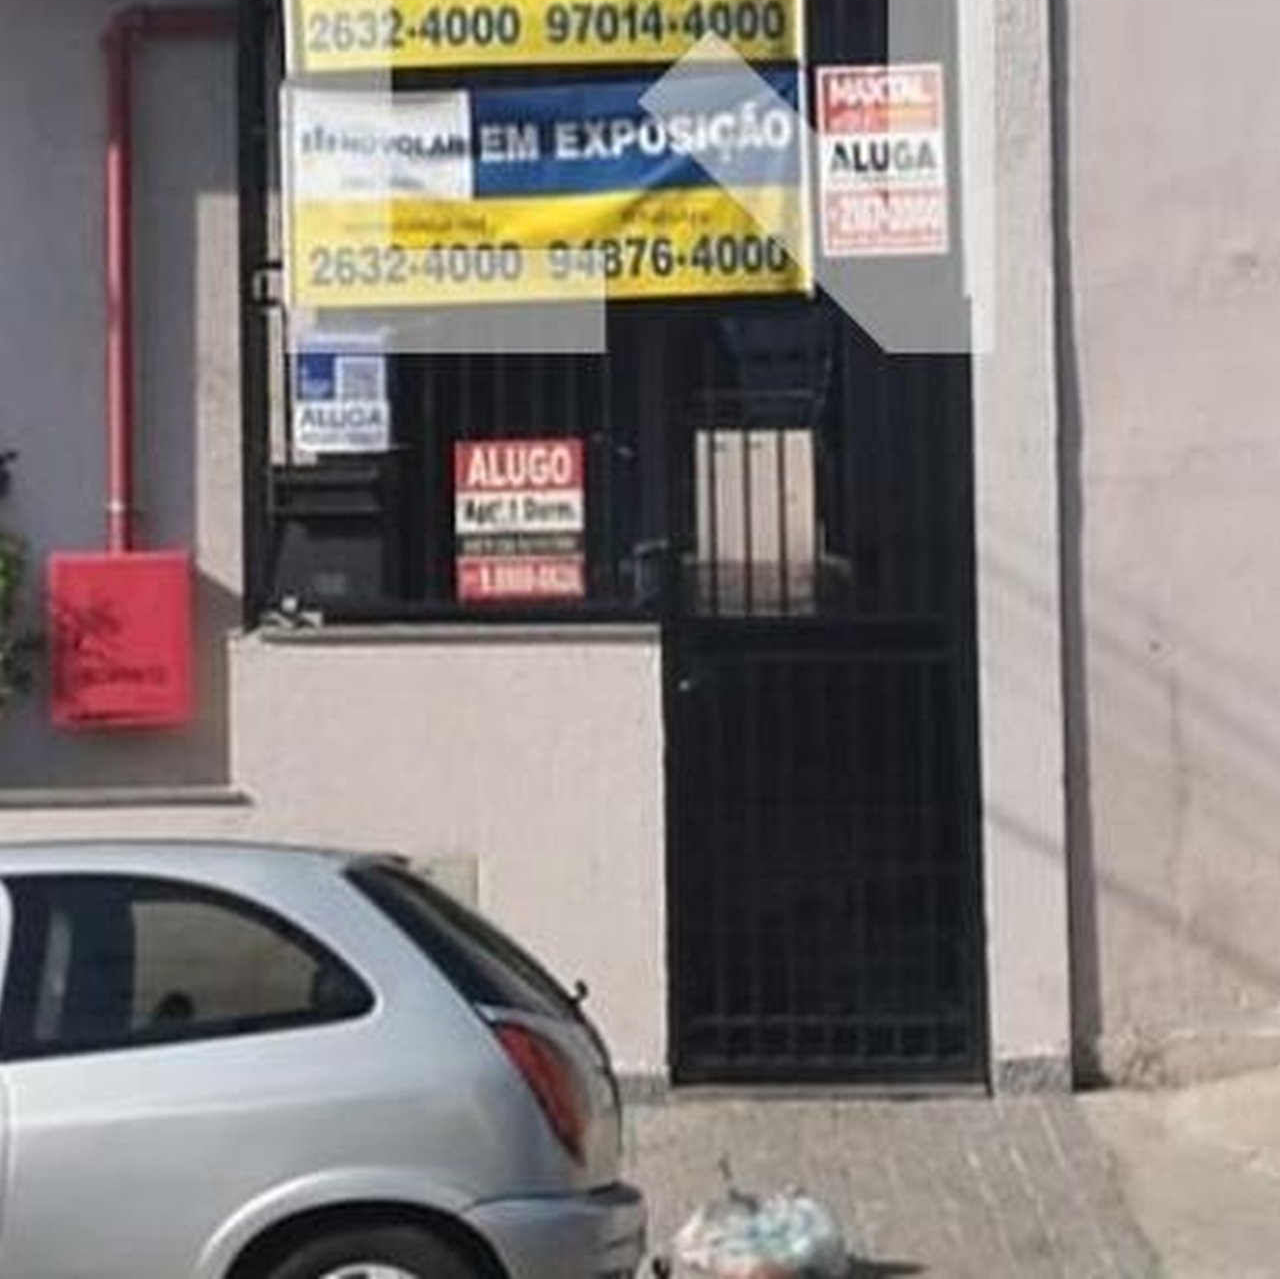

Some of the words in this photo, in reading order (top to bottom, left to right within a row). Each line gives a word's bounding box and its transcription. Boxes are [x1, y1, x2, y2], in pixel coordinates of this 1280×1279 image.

[309, 5, 521, 52] 2632-4000
[546, 0, 786, 45] 97014-4000
[479, 123, 539, 162] EM
[555, 99, 792, 162] EXPOSIÇÃO
[830, 139, 936, 174] ALUGA
[310, 241, 523, 285] 2632-4000
[548, 234, 788, 280] 94876-4000
[300, 408, 383, 428] ALUGA
[468, 446, 572, 487] ALUGO
